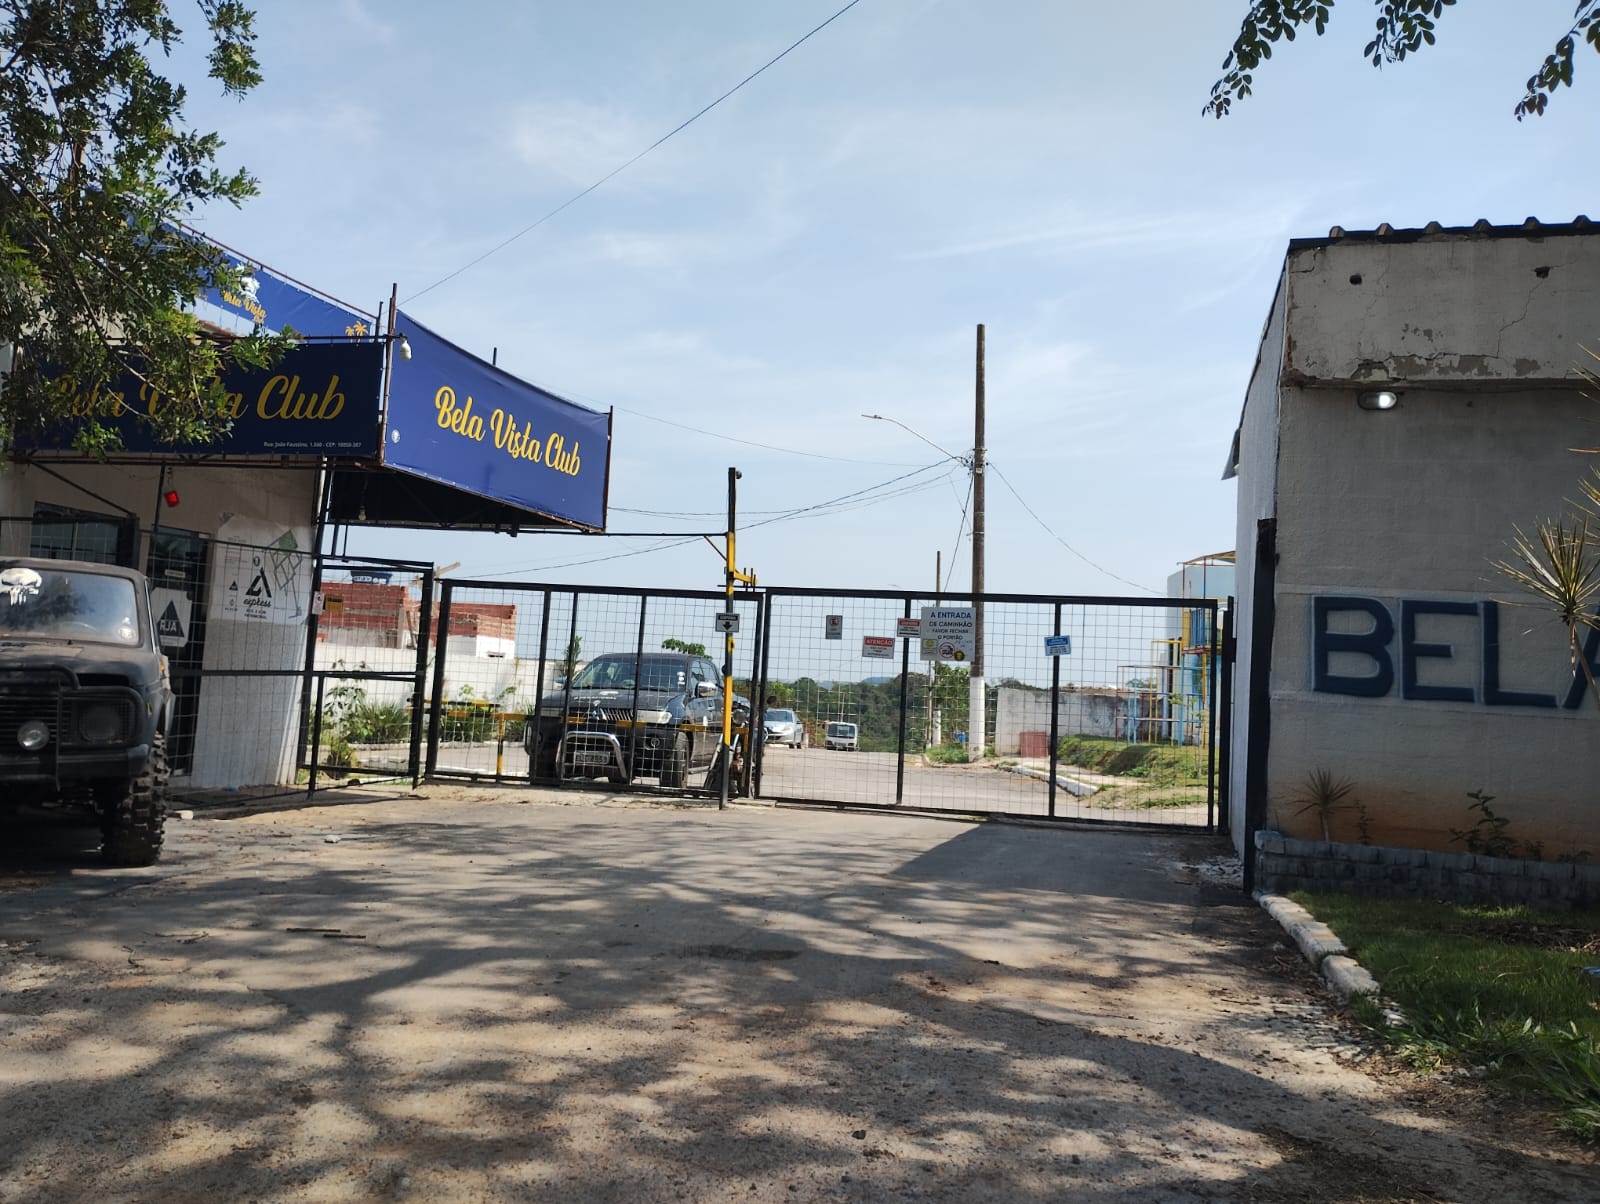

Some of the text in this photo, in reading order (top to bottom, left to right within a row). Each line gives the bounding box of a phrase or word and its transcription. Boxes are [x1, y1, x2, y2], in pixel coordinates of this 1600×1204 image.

[256, 375, 345, 420] Club
[435, 386, 581, 476] Bela Vista Club
[938, 611, 971, 619] ENTRADA
[159, 619, 177, 632] RJA
[865, 638, 893, 646] ATENÇÃO
